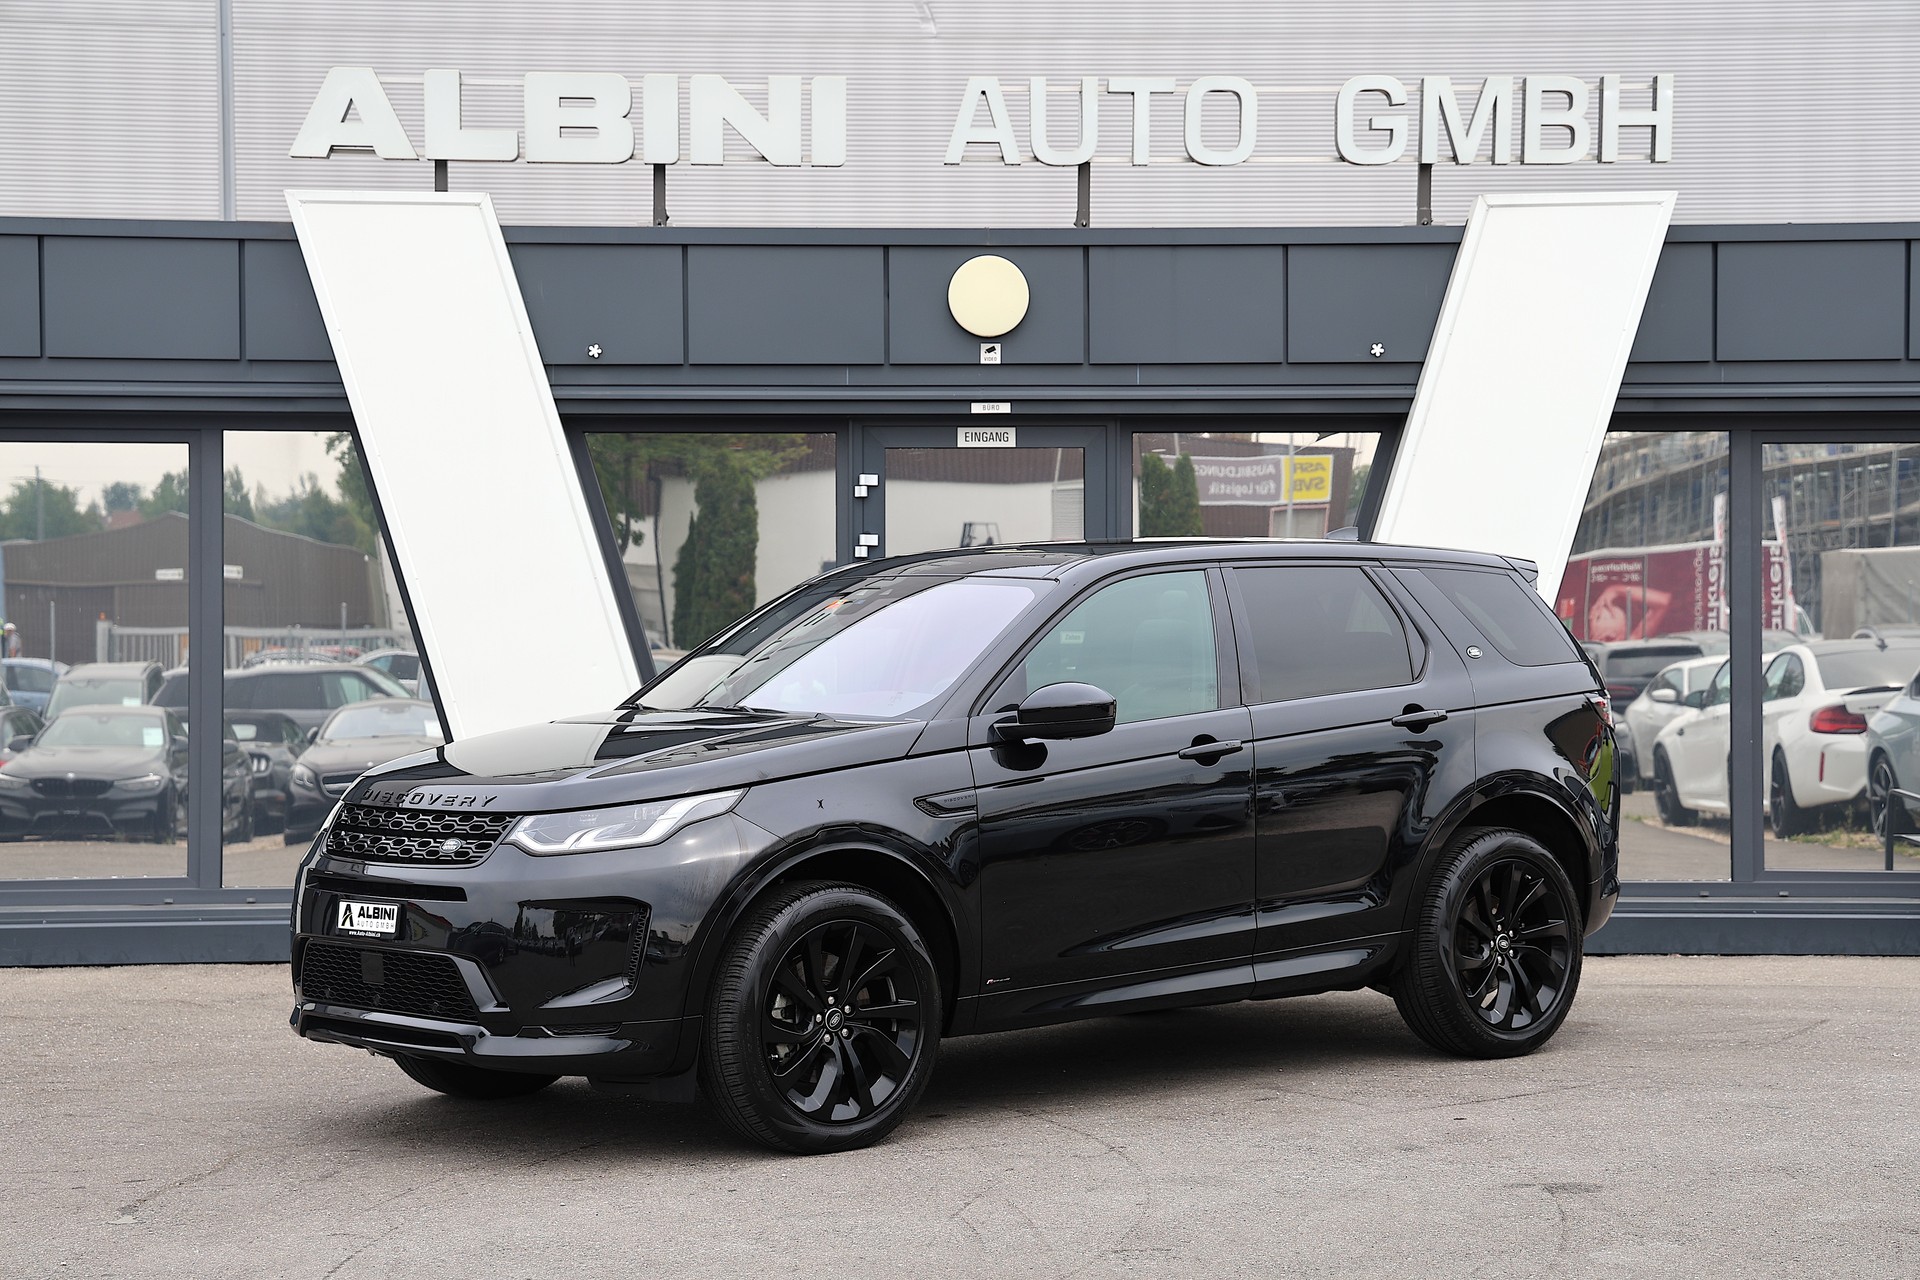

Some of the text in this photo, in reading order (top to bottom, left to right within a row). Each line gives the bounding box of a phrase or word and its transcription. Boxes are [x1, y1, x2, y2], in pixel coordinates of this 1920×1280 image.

[289, 66, 1674, 167] ALBINI AUTO GMBH
[982, 403, 1000, 411] BÜRO
[964, 431, 1009, 443] EINGANG
[363, 788, 498, 808] DISCOVERY
[357, 905, 395, 921] ALBINI
[356, 919, 395, 930] AUTO GMBH
